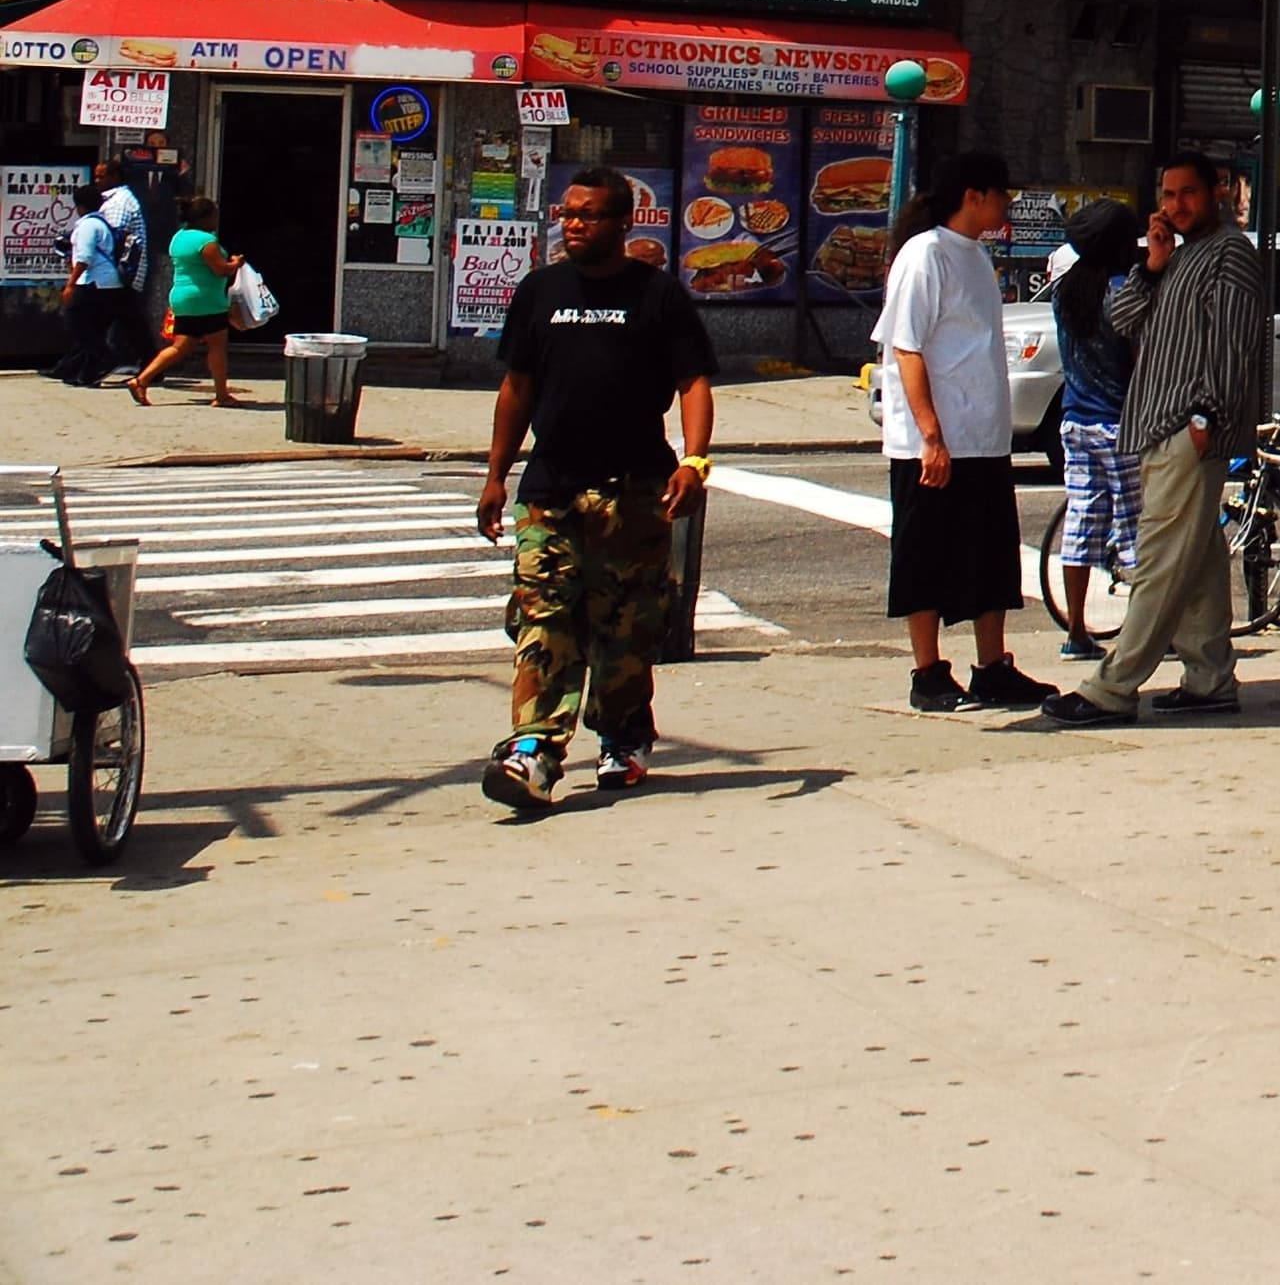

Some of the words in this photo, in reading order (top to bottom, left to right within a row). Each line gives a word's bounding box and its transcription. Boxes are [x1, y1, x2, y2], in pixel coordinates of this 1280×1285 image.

[4, 41, 66, 60] LOTTO
[191, 41, 239, 58] ATM
[264, 46, 347, 72] OPEN
[574, 36, 762, 65] ELECTRONICS
[775, 48, 928, 71] NEWSSTA
[90, 69, 166, 90] ATM
[629, 62, 682, 75] SCHOOL
[687, 66, 751, 79] SUPPLIES
[763, 70, 799, 82] FILMS
[813, 72, 880, 87] BATTERIES
[687, 77, 762, 92] MAGAZINES
[777, 82, 824, 95] COFFEE
[520, 91, 565, 108] ATM
[701, 105, 787, 123] GRILLED
[695, 125, 790, 143] SANDWICHES
[813, 128, 894, 145] SANDWICH
[8, 205, 48, 220] Bad
[462, 255, 500, 271] Bad
[465, 270, 508, 287] Girls
